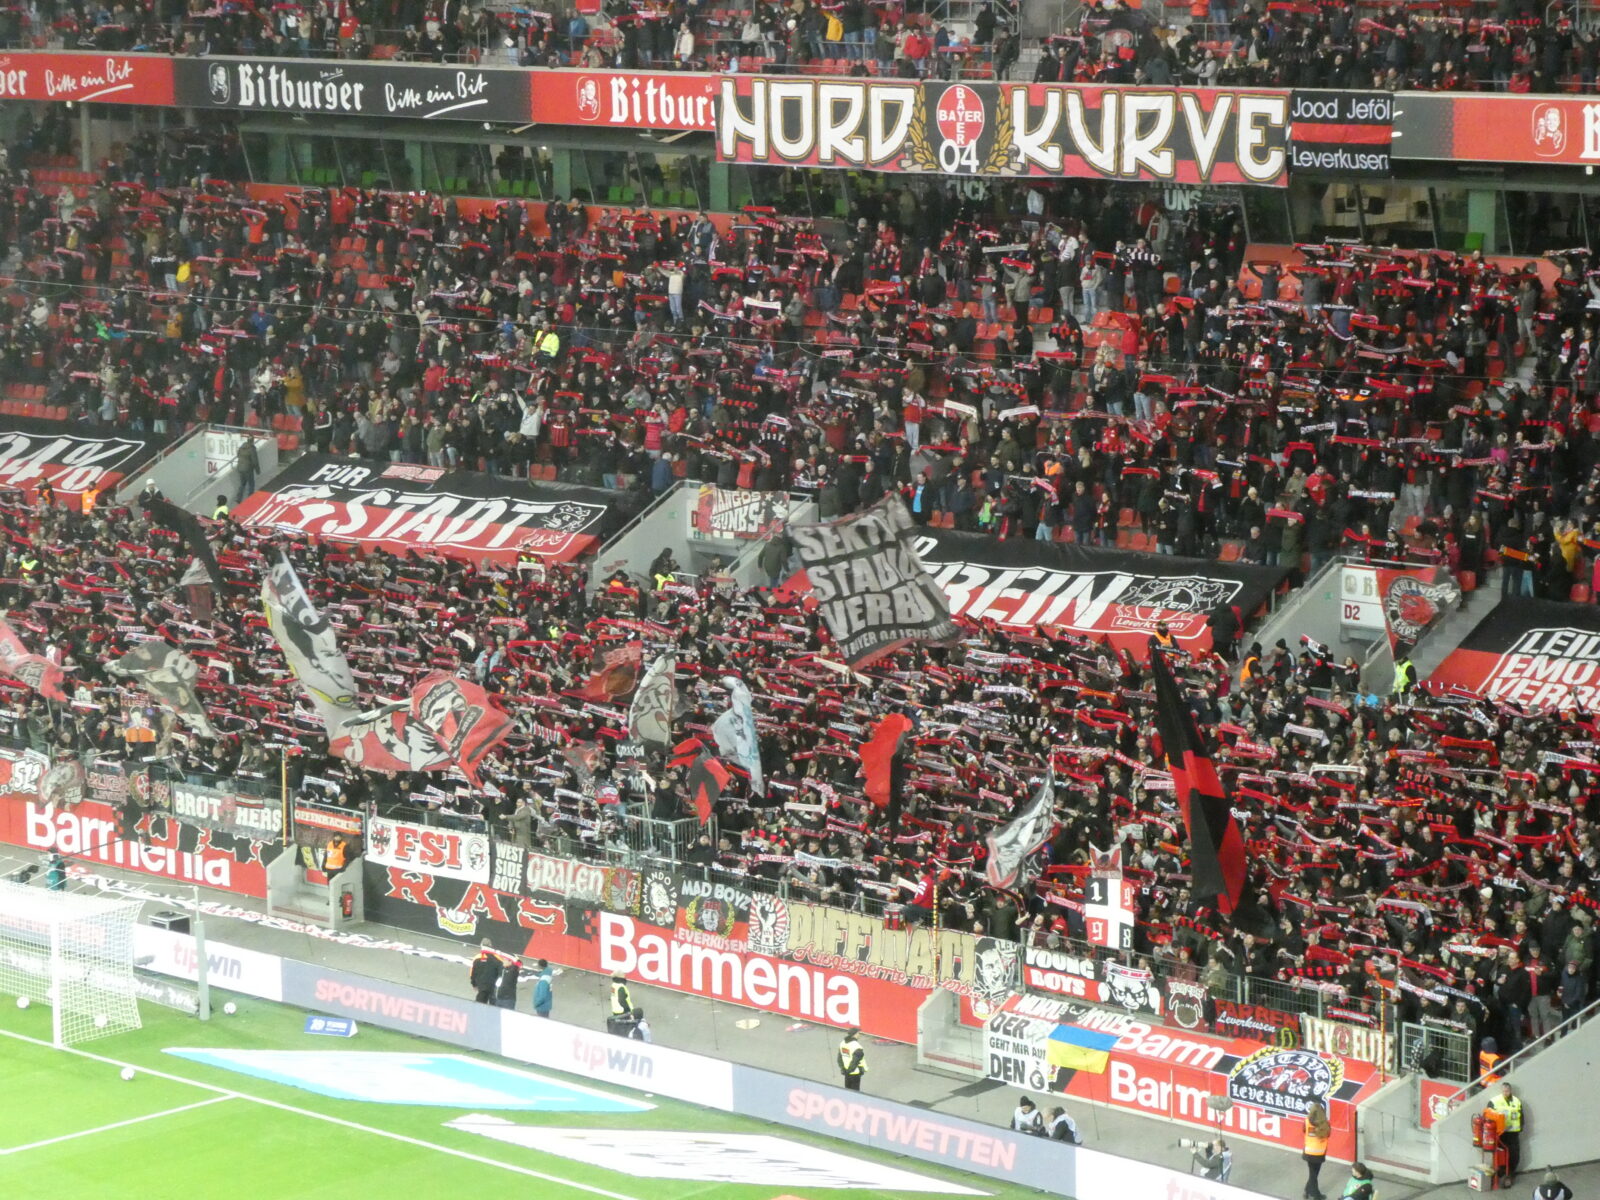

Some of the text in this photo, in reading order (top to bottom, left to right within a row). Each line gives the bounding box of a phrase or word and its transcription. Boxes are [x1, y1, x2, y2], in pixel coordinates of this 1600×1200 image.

[45, 58, 133, 96] Bitte ein Bit
[238, 64, 364, 111] Bitburger
[385, 72, 488, 112] Bitte ein Bit
[609, 76, 716, 126] Bitbur
[939, 109, 982, 122] BAYER
[1292, 97, 1391, 120] Jood Jeföl
[719, 78, 917, 167] NORD
[1010, 87, 1288, 185] KURVE
[939, 138, 980, 174] 04
[1292, 145, 1389, 170] Leverkusen
[308, 463, 371, 487] FÜR
[321, 487, 558, 548] STADT
[1344, 604, 1360, 620] D2
[175, 790, 221, 822] BROT
[394, 826, 463, 870] FSI
[496, 842, 524, 862] WEST
[493, 874, 522, 895] BOYZ
[495, 859, 523, 880] SIDE
[681, 879, 753, 911] MAD BOYZ
[1090, 882, 1103, 902] 1
[674, 927, 751, 953] EVERKUSEN
[1092, 921, 1131, 948] 9 8
[600, 911, 861, 1027] Barmenia
[1026, 947, 1095, 980] YOUNG
[1030, 968, 1086, 997] BOYS
[314, 977, 468, 1035] SPORTWETTEN
[1217, 1010, 1276, 1032] Leverkusen
[990, 1011, 1030, 1040] DER
[571, 1030, 654, 1079] tipwin
[989, 1036, 1010, 1052] GEHT
[1012, 1041, 1030, 1056] MIR
[1111, 1022, 1226, 1070] Barm
[989, 1053, 1026, 1085] DEN
[1110, 1060, 1283, 1138] Barmnia
[1231, 1083, 1325, 1113] LEVERKUSE
[785, 1088, 1016, 1171] SPORTWETTEN
